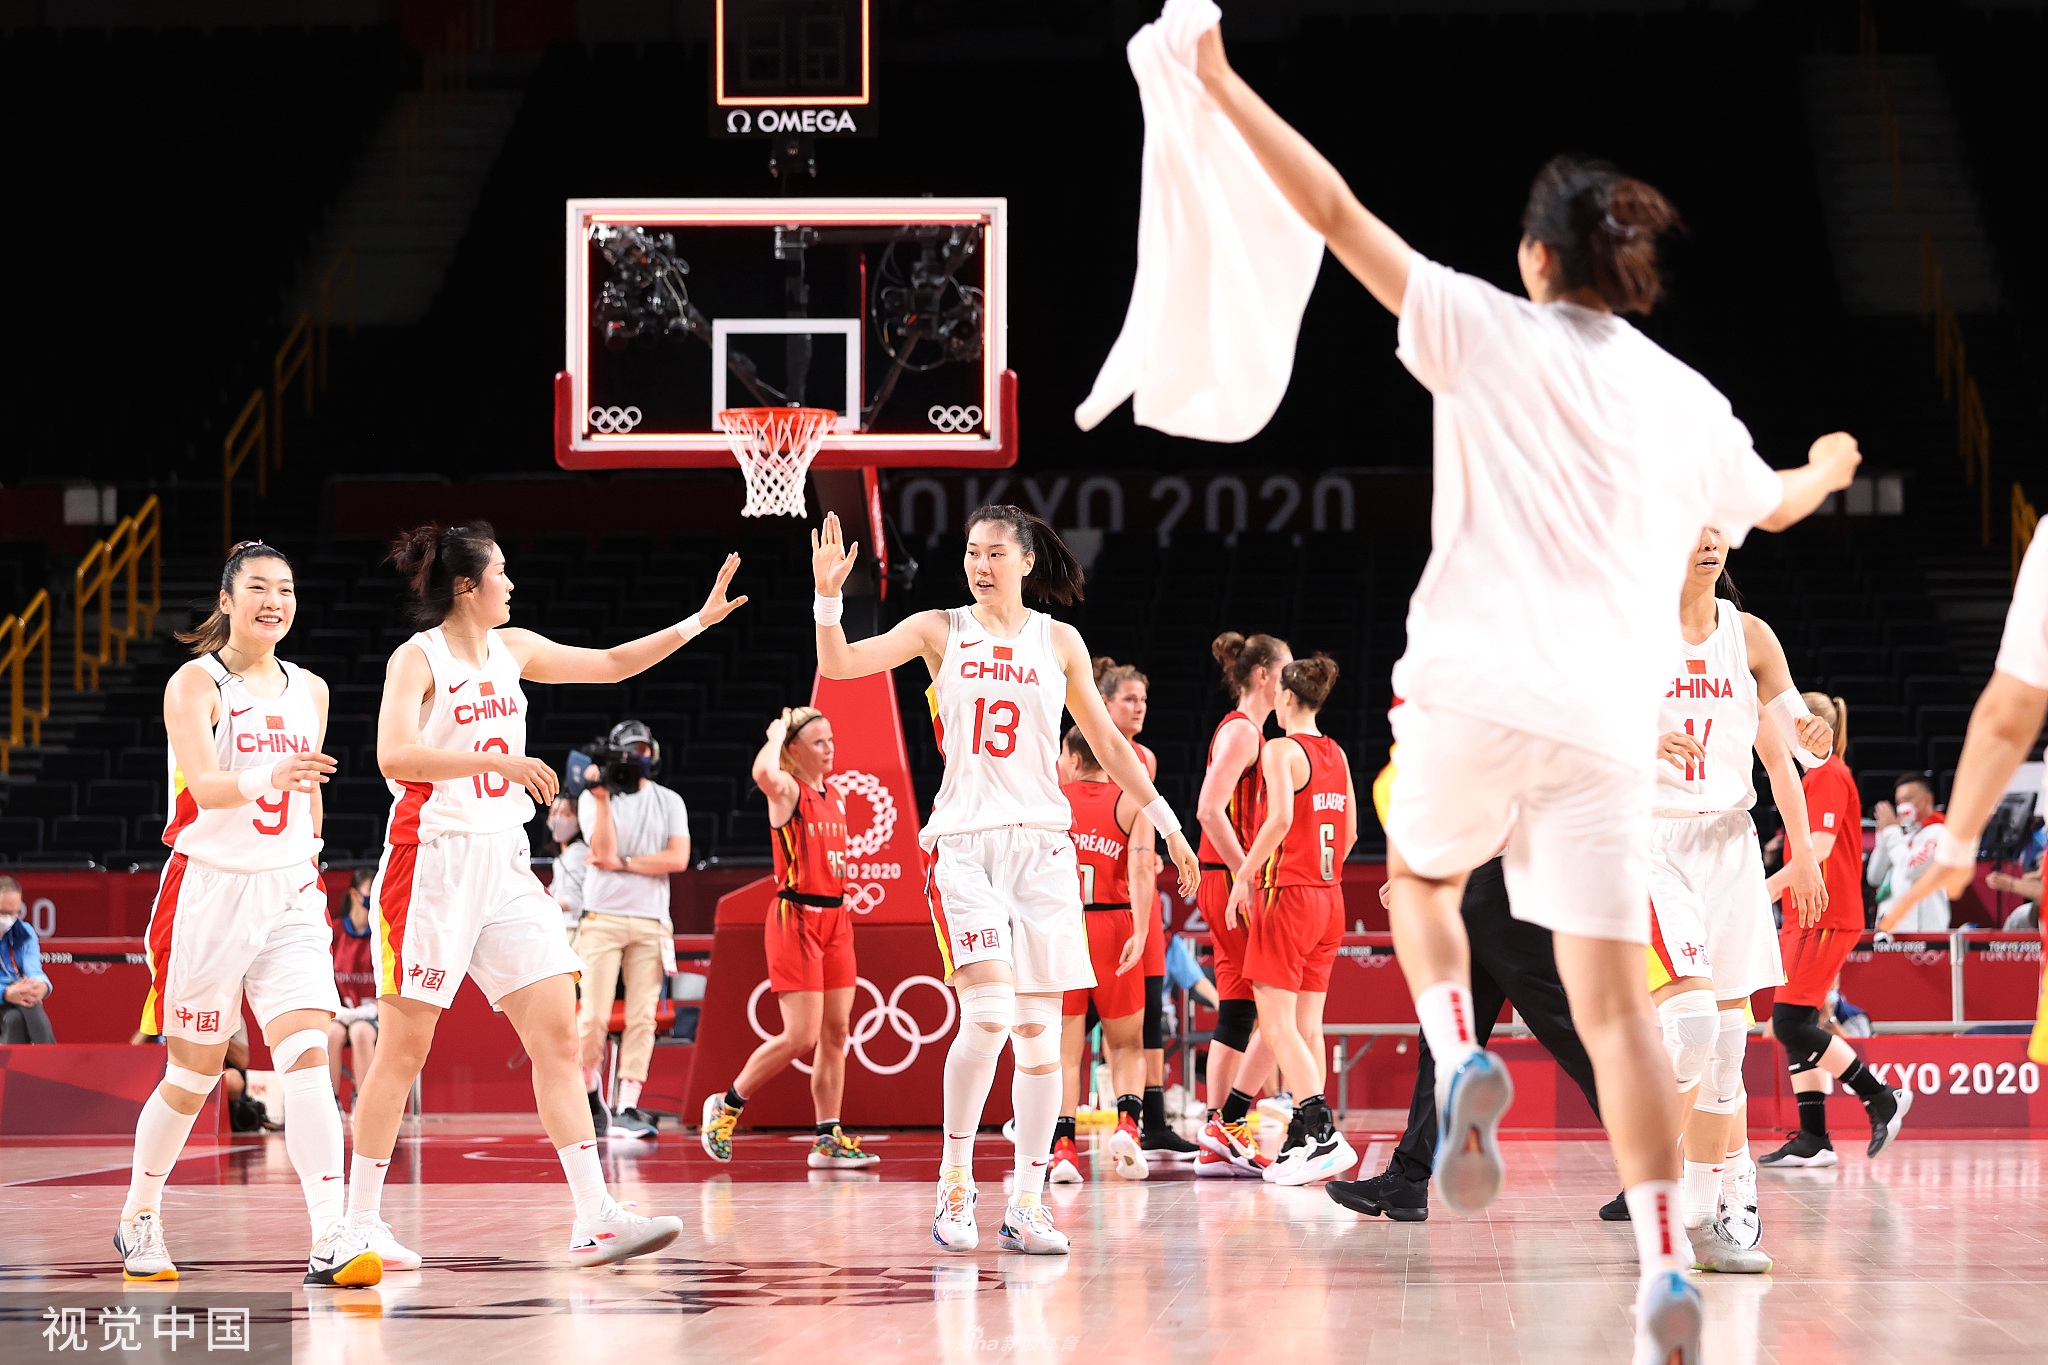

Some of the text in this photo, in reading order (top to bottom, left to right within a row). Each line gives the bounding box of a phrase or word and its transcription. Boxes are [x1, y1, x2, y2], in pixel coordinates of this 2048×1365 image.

[757, 109, 857, 133] OMEGA
[882, 475, 1356, 549] OKYO 2020
[960, 661, 1040, 686] CHINA
[454, 696, 519, 725] CHINA
[972, 697, 1021, 758] 13
[236, 733, 311, 753] CHINA
[1684, 718, 1713, 781] 11
[472, 737, 510, 799] 10
[252, 791, 291, 836] 9
[1312, 792, 1347, 813] DELAERE
[827, 850, 847, 879] 35
[1319, 822, 1335, 881] 6
[860, 862, 902, 880] 2020
[959, 928, 1001, 952] 中国
[126, 952, 147, 964] TOK
[408, 963, 446, 991] 中国
[175, 1006, 220, 1033] 中国
[1948, 1062, 2040, 1095] 2020
